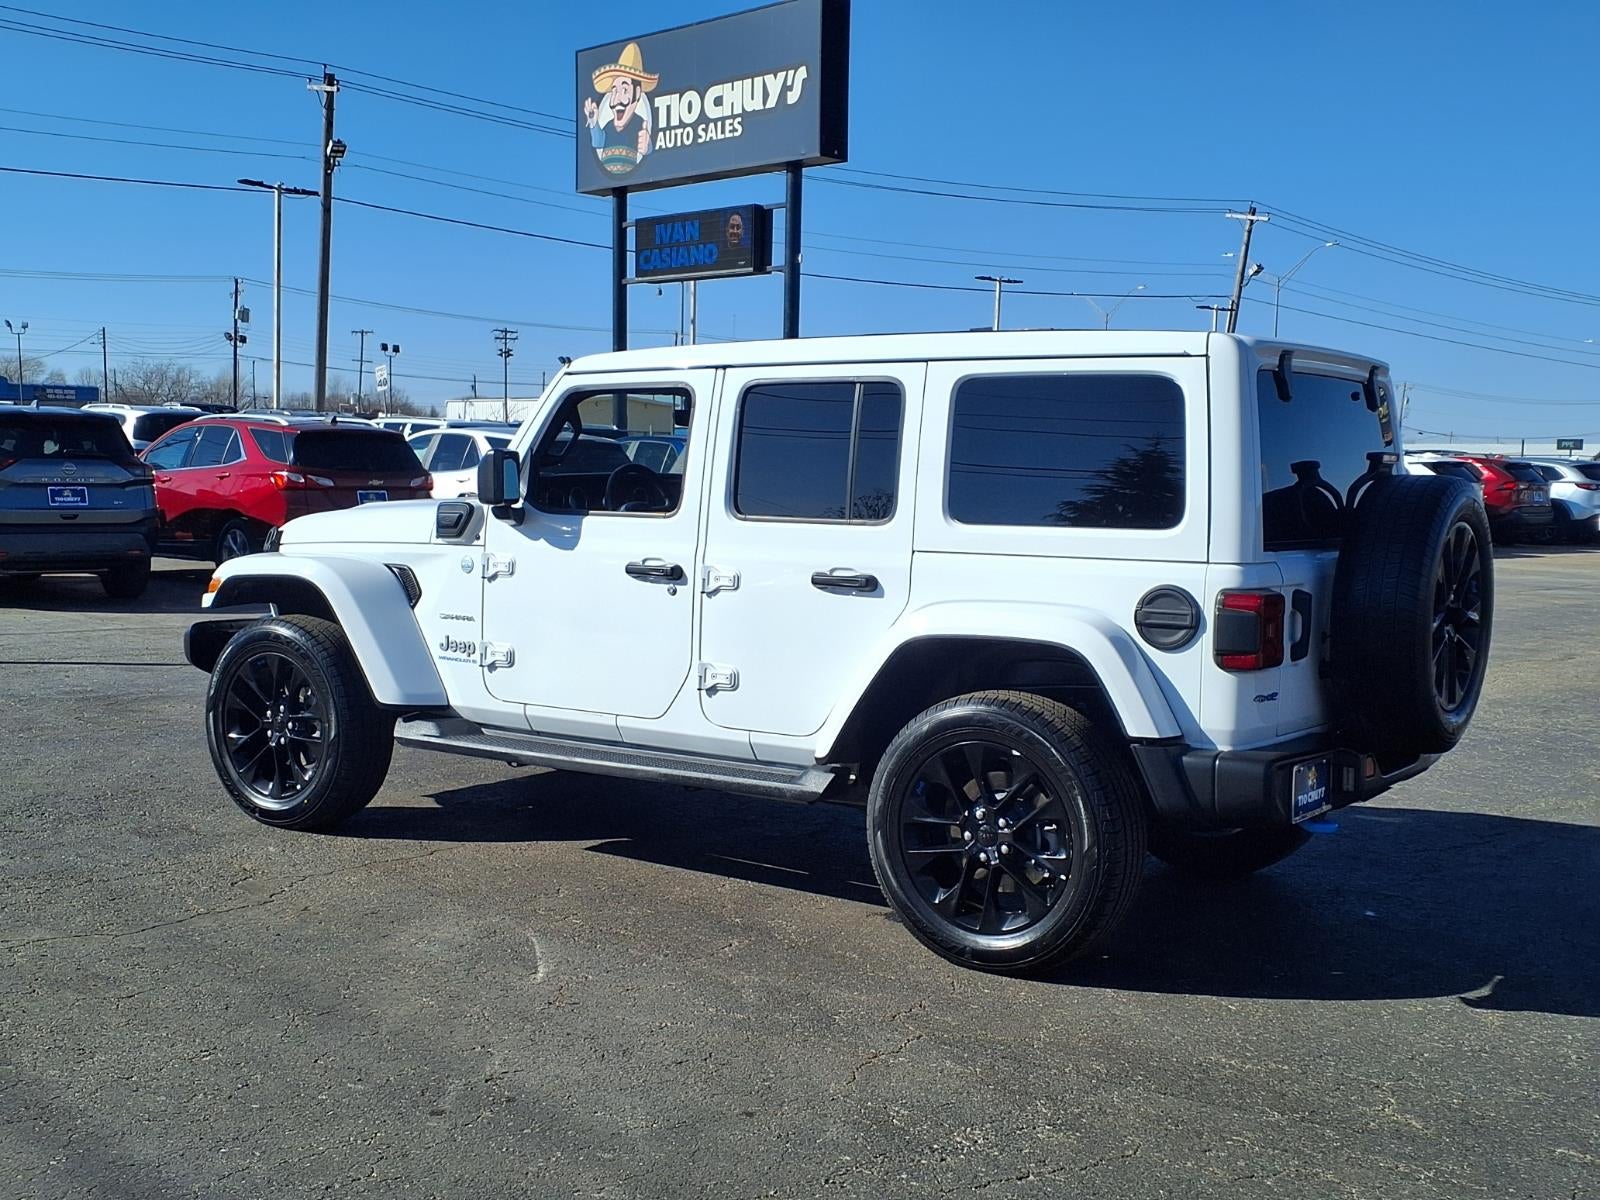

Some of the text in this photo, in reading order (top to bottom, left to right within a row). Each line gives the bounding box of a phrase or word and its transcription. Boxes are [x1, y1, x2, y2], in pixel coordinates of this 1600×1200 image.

[654, 65, 808, 129] TIO CHUY'S
[654, 117, 743, 150] AUTO SALES
[655, 219, 700, 245] IVAN
[638, 242, 719, 271] CASIANO
[377, 377, 388, 387] 40
[439, 634, 476, 657] Jeep
[1298, 793, 1308, 807] TIO
